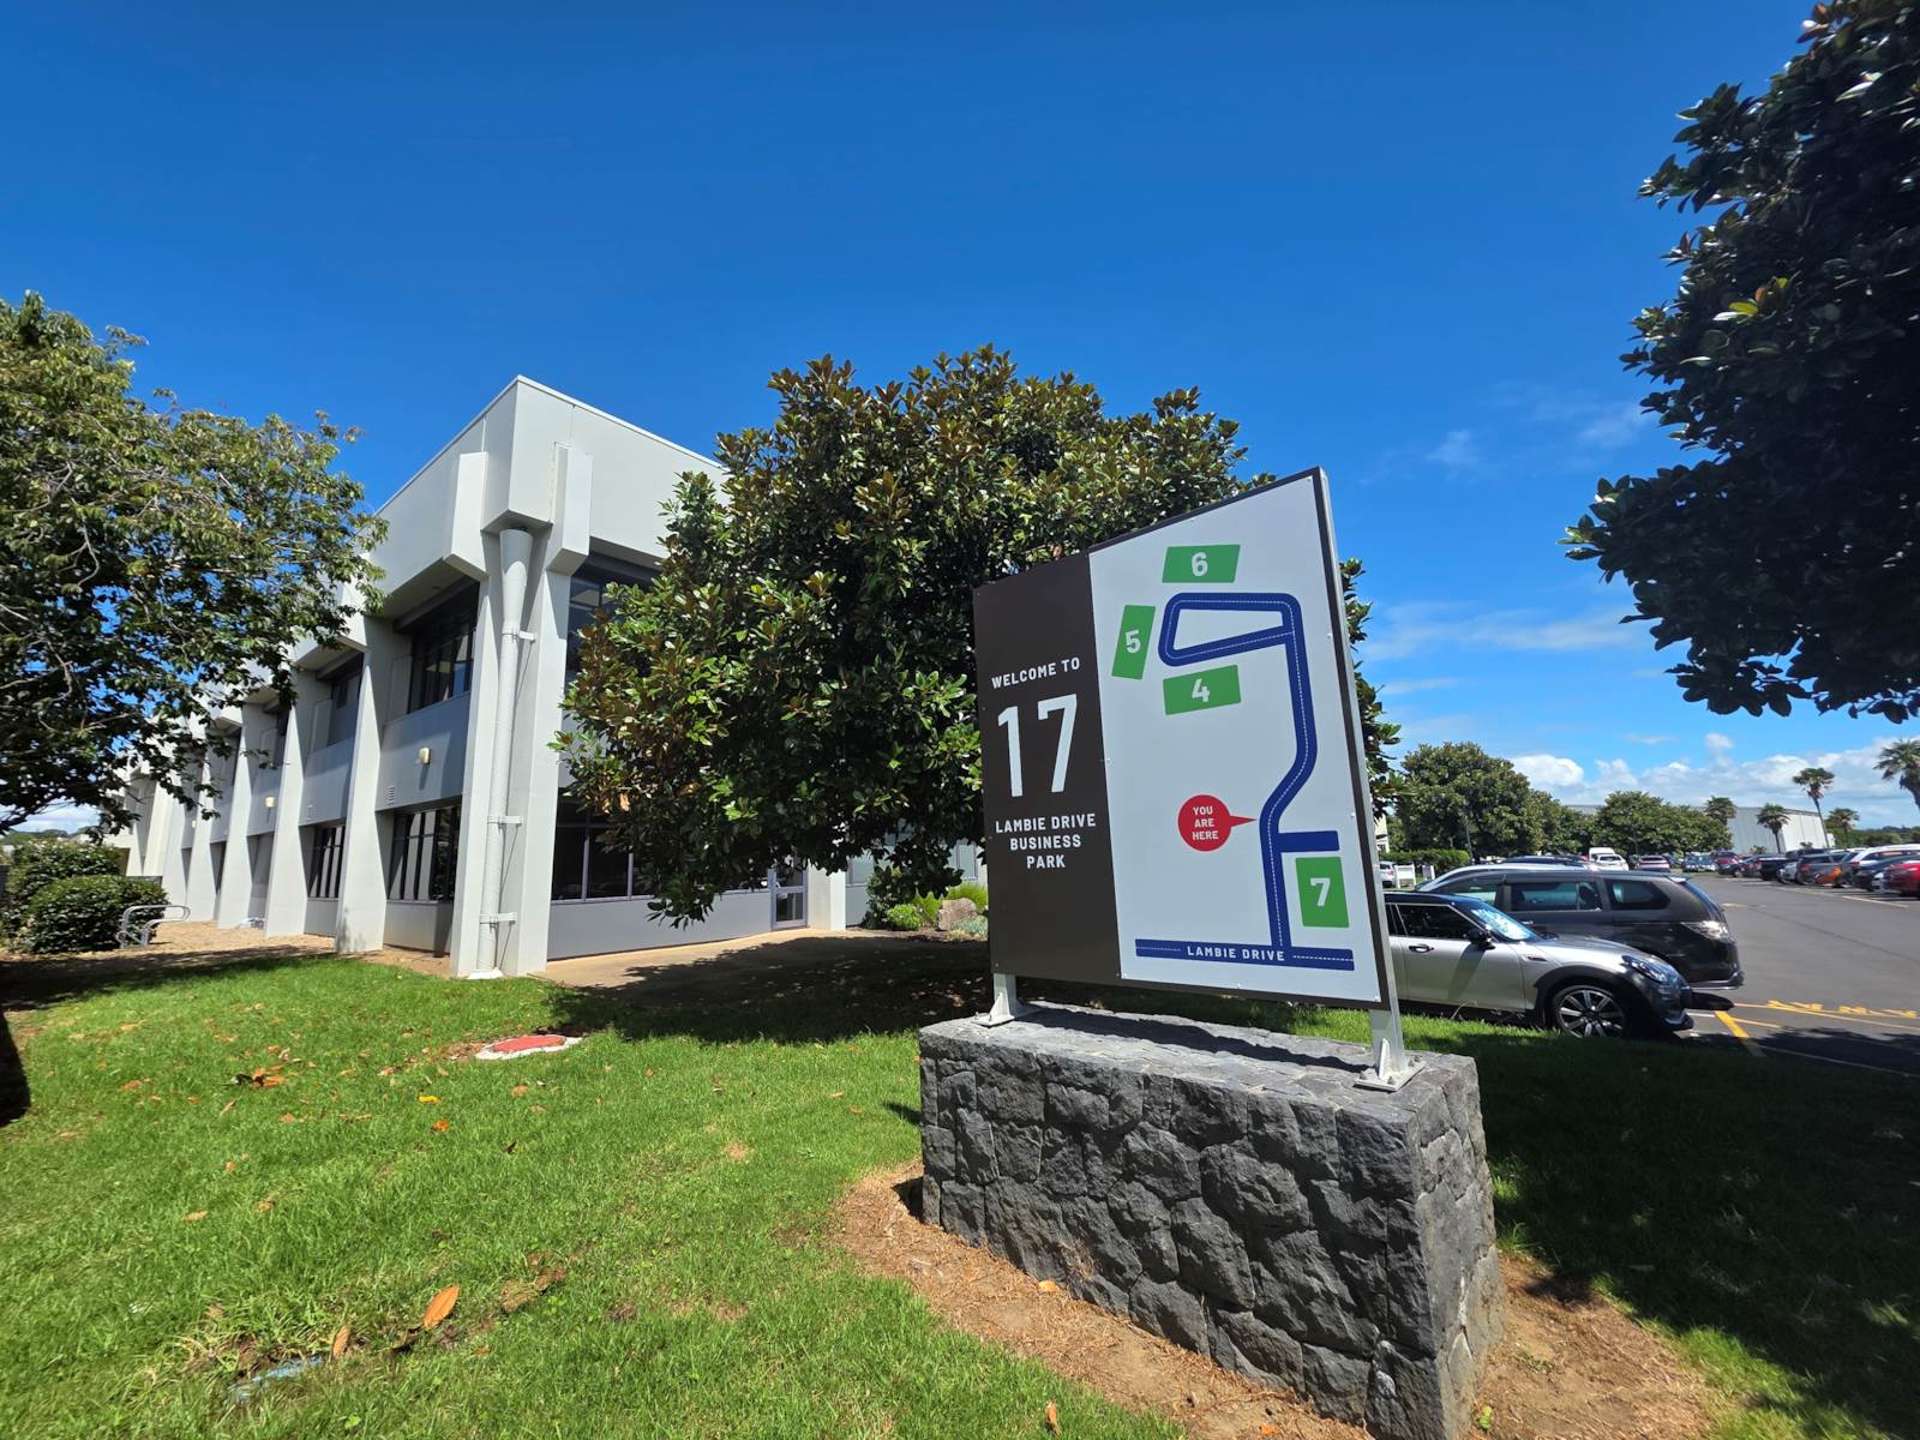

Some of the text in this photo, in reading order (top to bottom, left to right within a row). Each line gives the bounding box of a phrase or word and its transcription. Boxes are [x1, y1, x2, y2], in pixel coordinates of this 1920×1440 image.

[1192, 552, 1208, 576] 6
[1125, 630, 1141, 653] 5
[991, 656, 1080, 689] WELCOME TO
[1191, 678, 1209, 702] 4
[997, 694, 1078, 797] 17
[1193, 806, 1213, 817] YOU
[995, 812, 1096, 833] LAMBIE DRIVE
[1194, 818, 1215, 828] ARE
[1010, 833, 1081, 850] BUSINESS
[1191, 830, 1219, 841] HERE
[1026, 854, 1066, 869] PARK
[1310, 877, 1330, 907] 7
[1187, 945, 1285, 962] LAMBIE DRIVE
